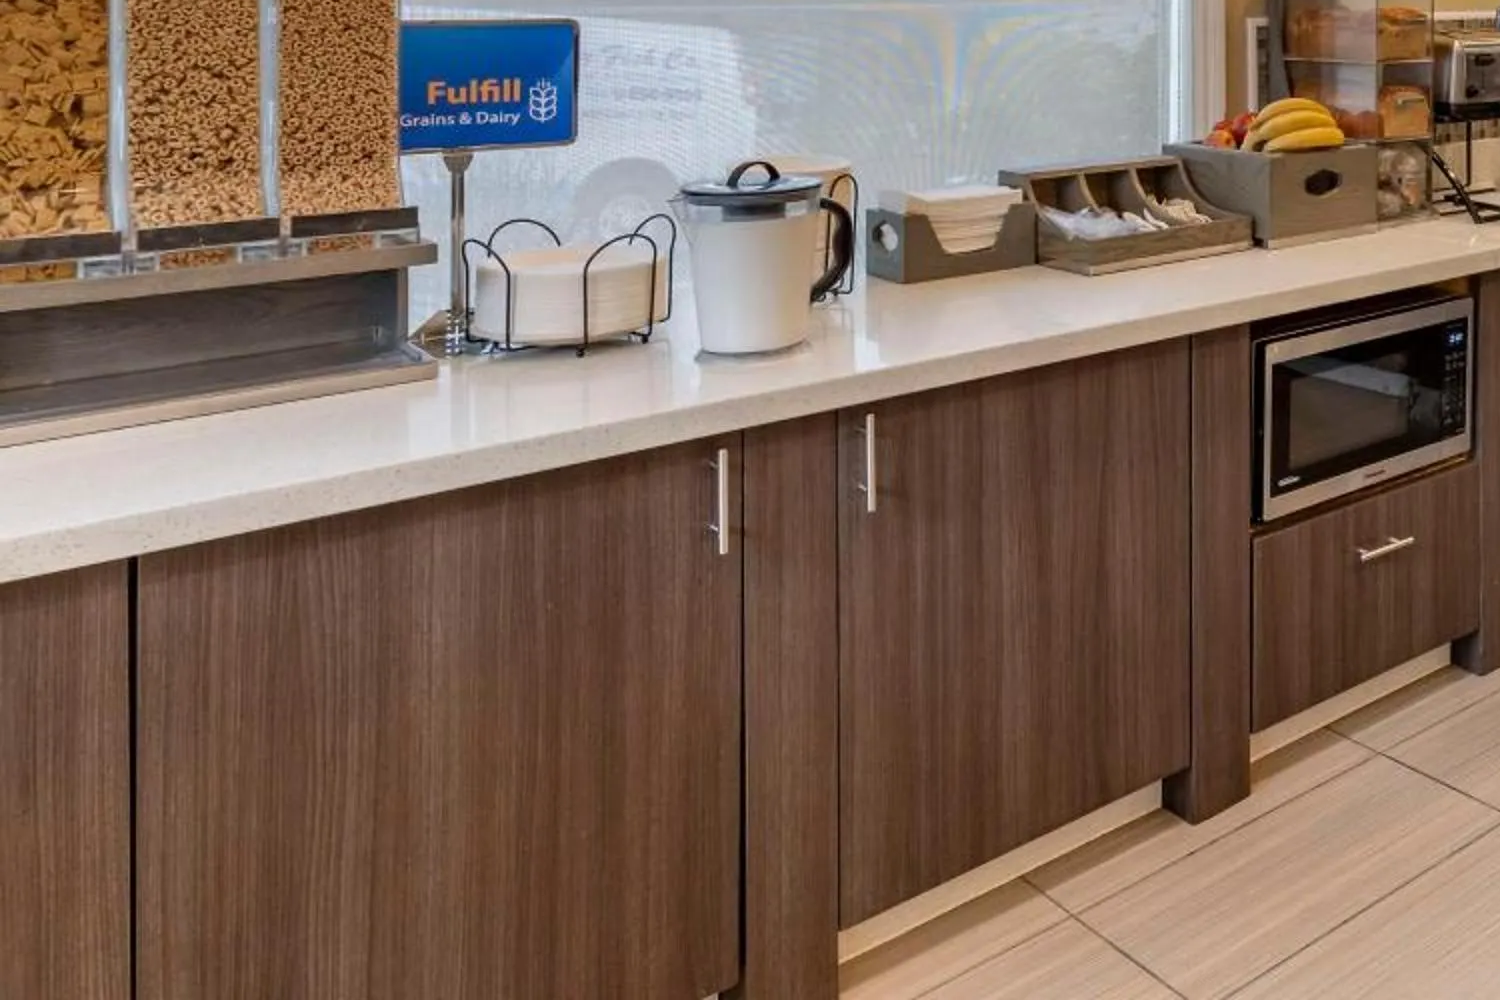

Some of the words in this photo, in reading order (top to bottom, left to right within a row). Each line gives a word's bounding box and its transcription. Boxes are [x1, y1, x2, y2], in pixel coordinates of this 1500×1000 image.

[426, 78, 521, 105] Fulfill
[400, 112, 455, 127] Grains
[459, 111, 473, 125] &
[475, 111, 521, 126] Dairy
